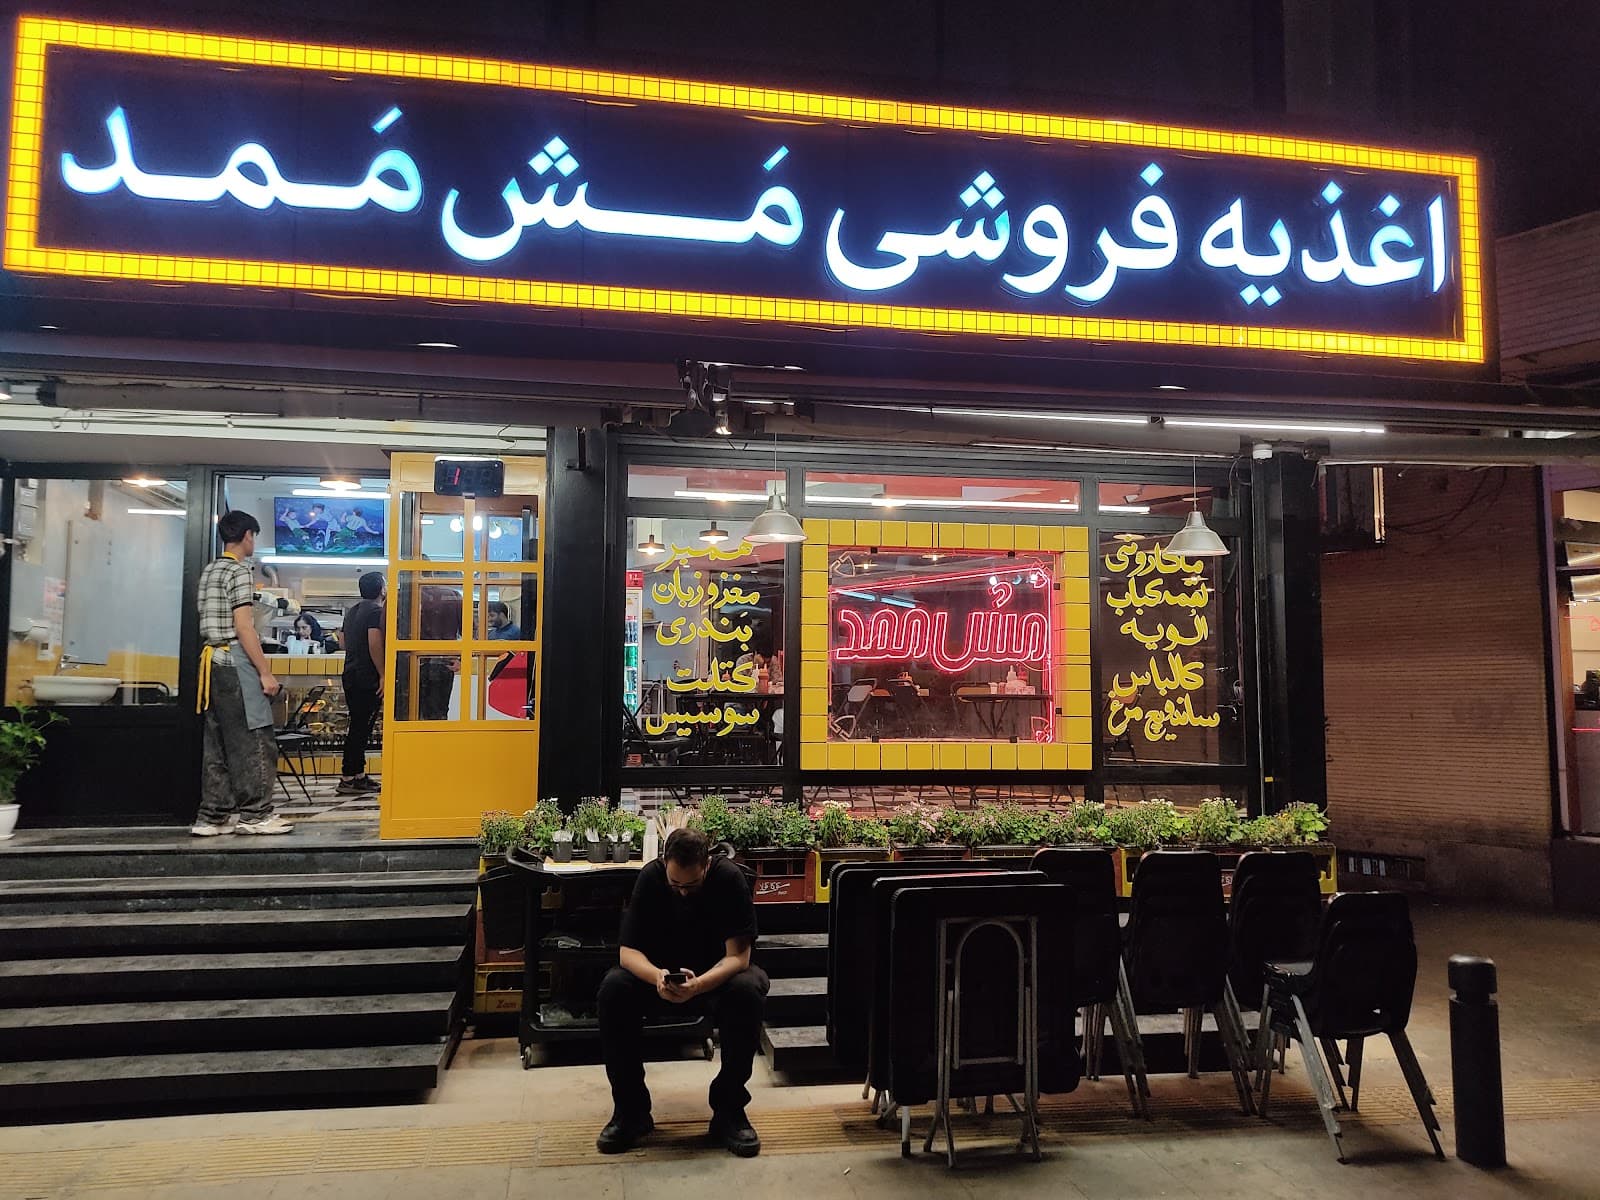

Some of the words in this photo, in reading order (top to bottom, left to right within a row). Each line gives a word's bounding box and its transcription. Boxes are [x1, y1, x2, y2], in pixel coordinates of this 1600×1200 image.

[824, 161, 1178, 303] فروشی
[1200, 180, 1447, 307] اغذیه
[653, 539, 754, 573] همبر
[1105, 535, 1204, 578] ماکارونی
[651, 566, 704, 608] زبان
[703, 582, 719, 606] و
[712, 571, 760, 609] مغز
[666, 656, 758, 693] کتلت
[1112, 652, 1205, 697] کالباس
[645, 705, 760, 737] سوسیس
[1107, 690, 1144, 736] مرغ
[1144, 692, 1221, 742] ساندویچ
